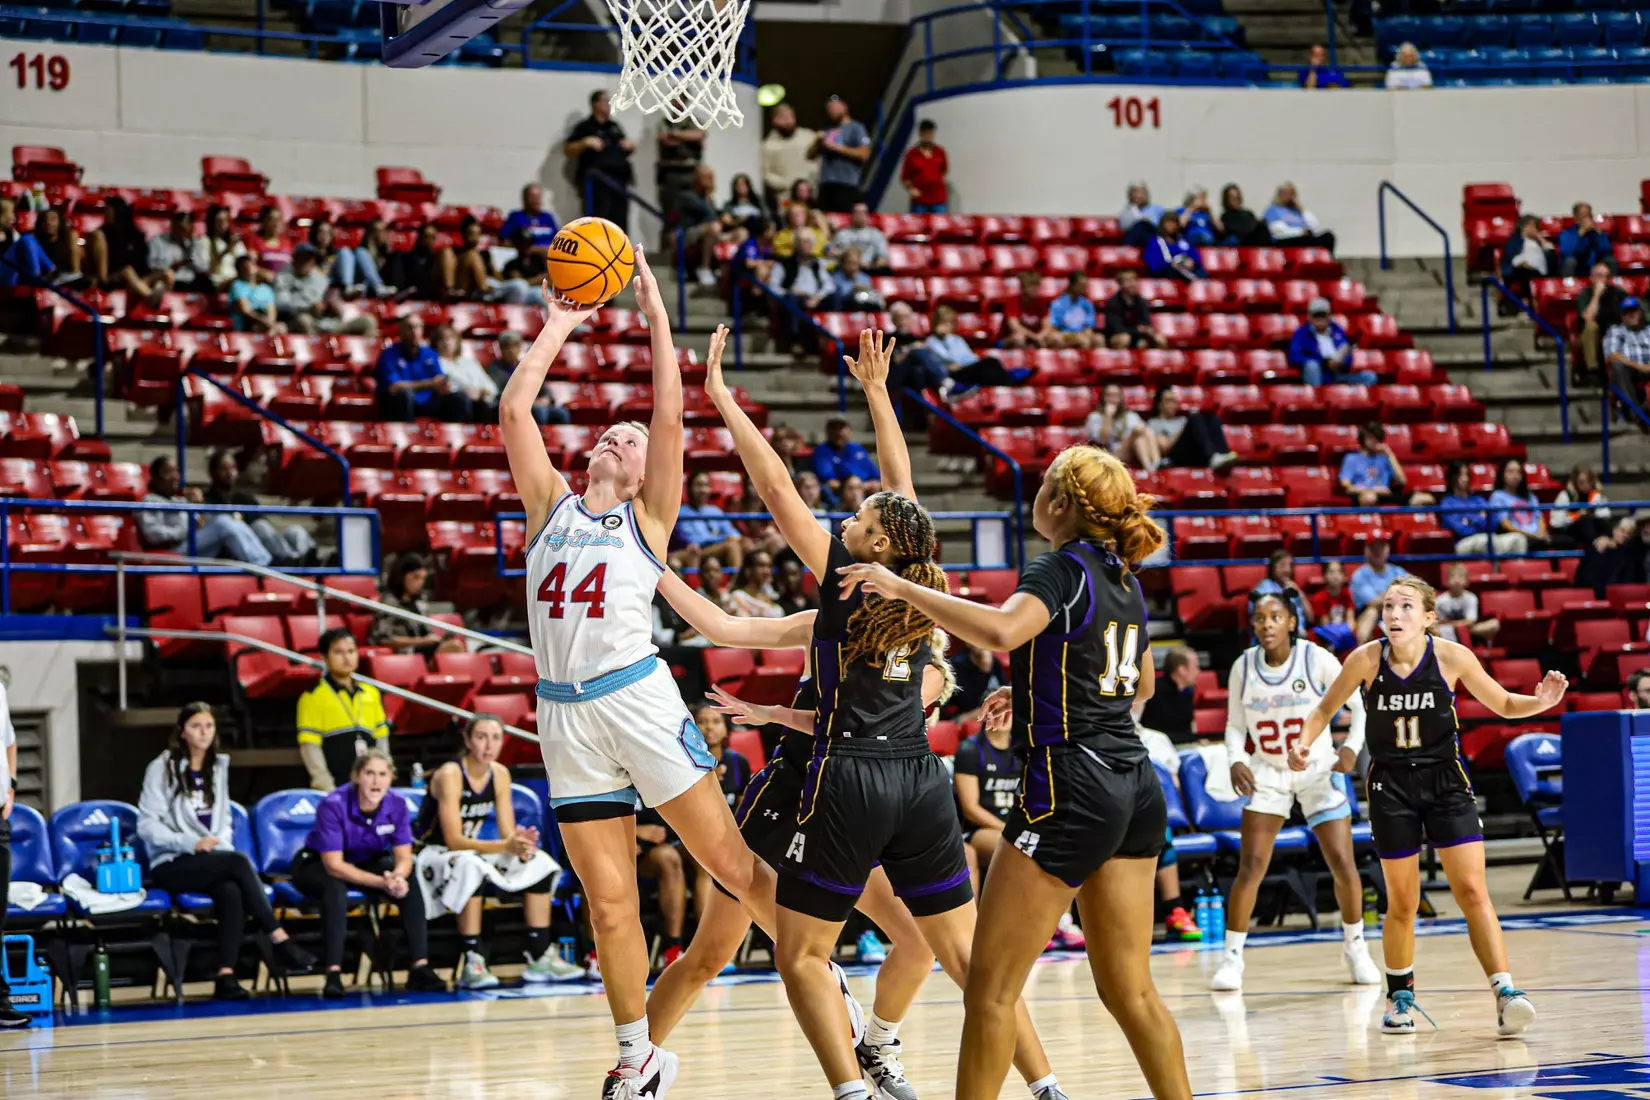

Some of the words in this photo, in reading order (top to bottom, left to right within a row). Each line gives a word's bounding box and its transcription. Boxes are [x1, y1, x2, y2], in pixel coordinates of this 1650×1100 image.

[9, 52, 70, 91] 119
[1107, 96, 1161, 129] 101
[537, 562, 607, 619] 44
[1099, 621, 1140, 696] 14
[1377, 692, 1435, 711] LSUA
[1256, 717, 1304, 754] 22
[1394, 715, 1421, 749] 11
